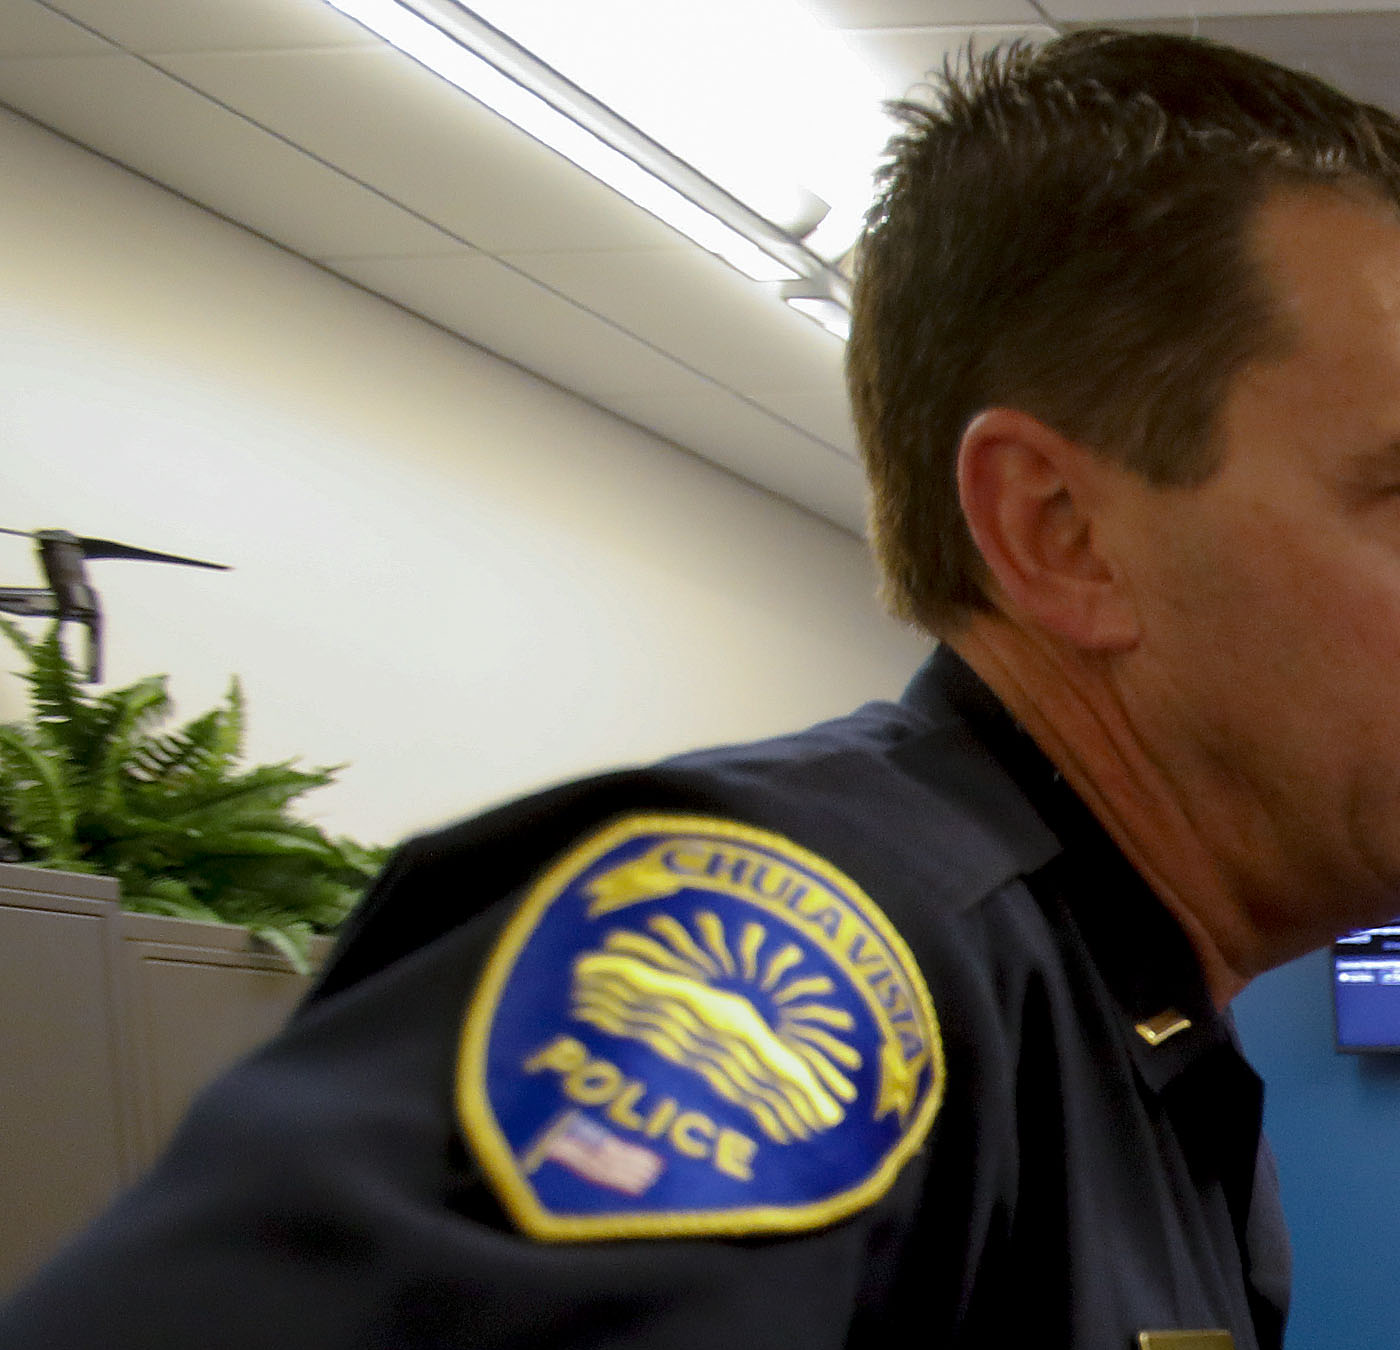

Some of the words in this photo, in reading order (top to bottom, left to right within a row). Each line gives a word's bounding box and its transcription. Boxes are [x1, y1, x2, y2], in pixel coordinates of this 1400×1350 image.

[660, 847, 843, 942] CHULA
[848, 930, 924, 1062] VISTA
[523, 1034, 759, 1182] POLICE
